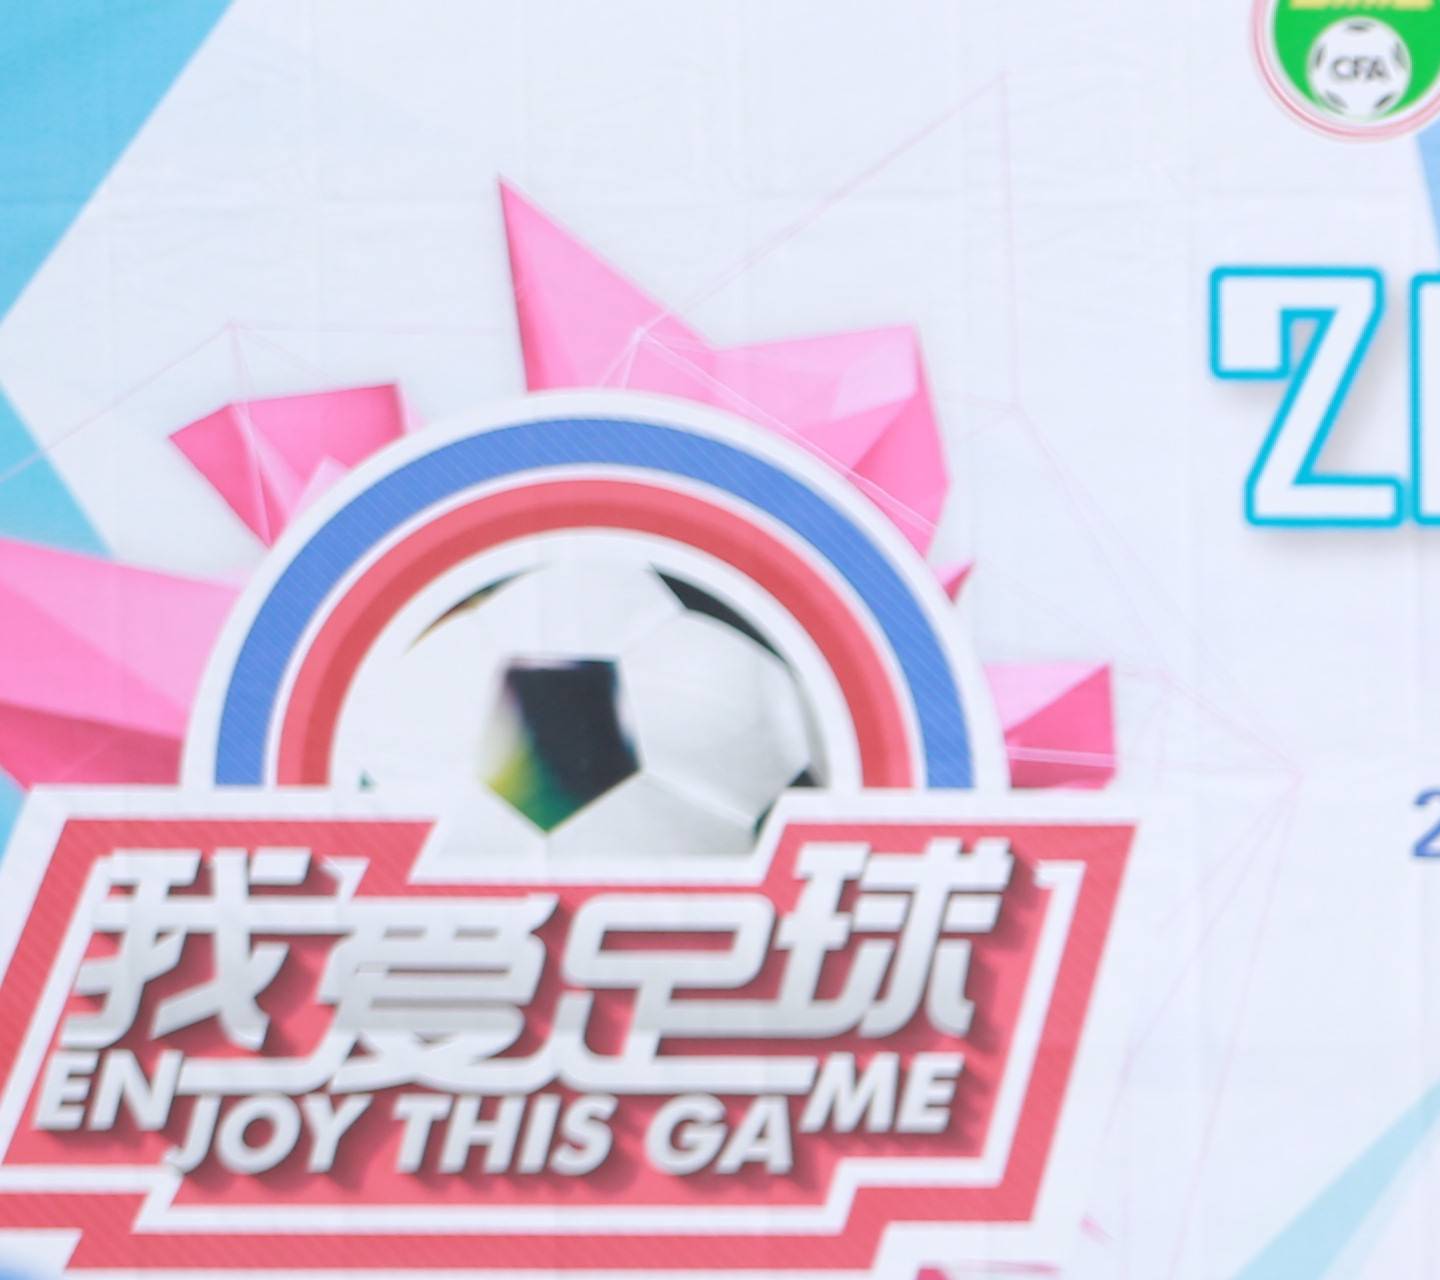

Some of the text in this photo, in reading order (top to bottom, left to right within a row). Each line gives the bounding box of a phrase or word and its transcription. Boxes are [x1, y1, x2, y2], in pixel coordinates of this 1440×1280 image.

[60, 838, 1016, 1096] 我爱足球
[32, 1050, 960, 1176] ENJOY THIS GAME
